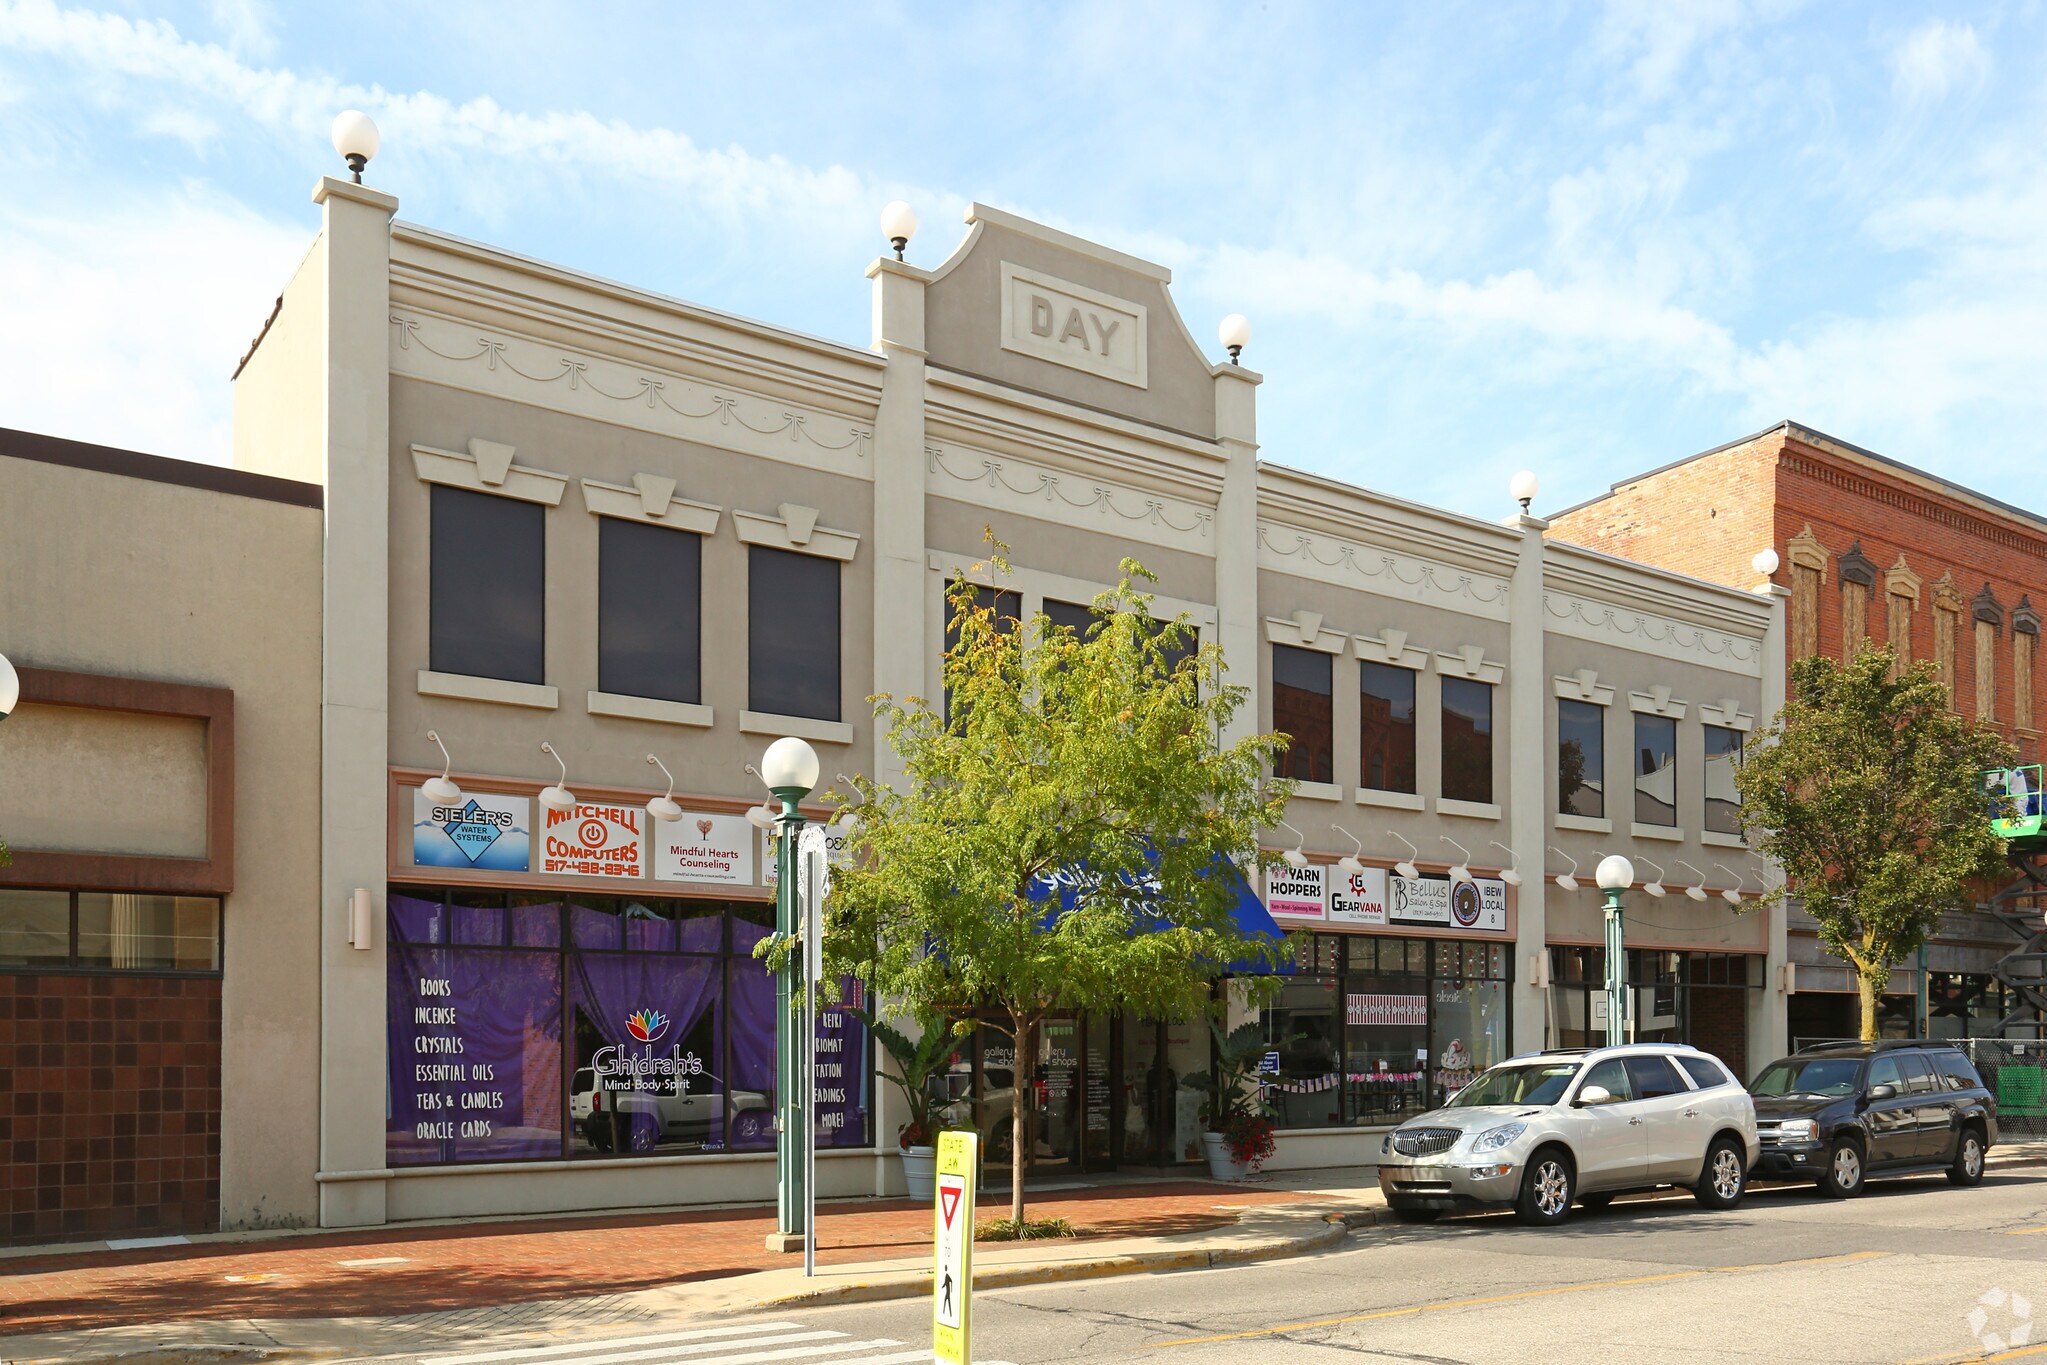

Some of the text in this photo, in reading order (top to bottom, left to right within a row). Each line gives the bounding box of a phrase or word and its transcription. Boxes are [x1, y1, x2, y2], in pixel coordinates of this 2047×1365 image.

[1031, 294, 1120, 357] DAY
[432, 806, 513, 827] SIELER'S
[547, 806, 640, 836] MITCHELL
[461, 826, 487, 834] WATER
[457, 834, 492, 842] SYSTEMS
[547, 836, 638, 862] COMPUTERS
[670, 846, 738, 859] Mindful Hearts
[545, 859, 640, 877] 517-438-8346
[680, 858, 730, 872] Counseling
[1289, 868, 1320, 882] YARN
[1271, 882, 1321, 897] HOPPERS
[1409, 882, 1447, 898] Bellus
[1484, 887, 1502, 897] IBEW
[1332, 893, 1382, 913] GEARVANA
[1481, 900, 1504, 911] LOCAL
[1491, 914, 1495, 923] 8
[420, 978, 451, 996] BOOKS
[415, 1007, 456, 1024] INCENSE
[822, 1012, 842, 1028] REIKI
[415, 1035, 464, 1054] CRYSTALS
[815, 1038, 843, 1053] BIOMAT
[984, 1046, 1013, 1058] gallery
[592, 1044, 703, 1075] Ghidrah's
[998, 1058, 1015, 1067] sho
[1052, 1058, 1077, 1067] shops
[416, 1064, 494, 1081] ESSENTIAL OILS
[605, 1079, 690, 1091] Mind Body Spirit
[417, 1092, 503, 1110] TEAS & CANDLES
[814, 1088, 846, 1103] EADINGS
[822, 1112, 844, 1128] MORE!
[417, 1120, 492, 1139] ORACLE CARDS
[943, 1138, 963, 1153] STATE
[944, 1157, 958, 1170] LAW
